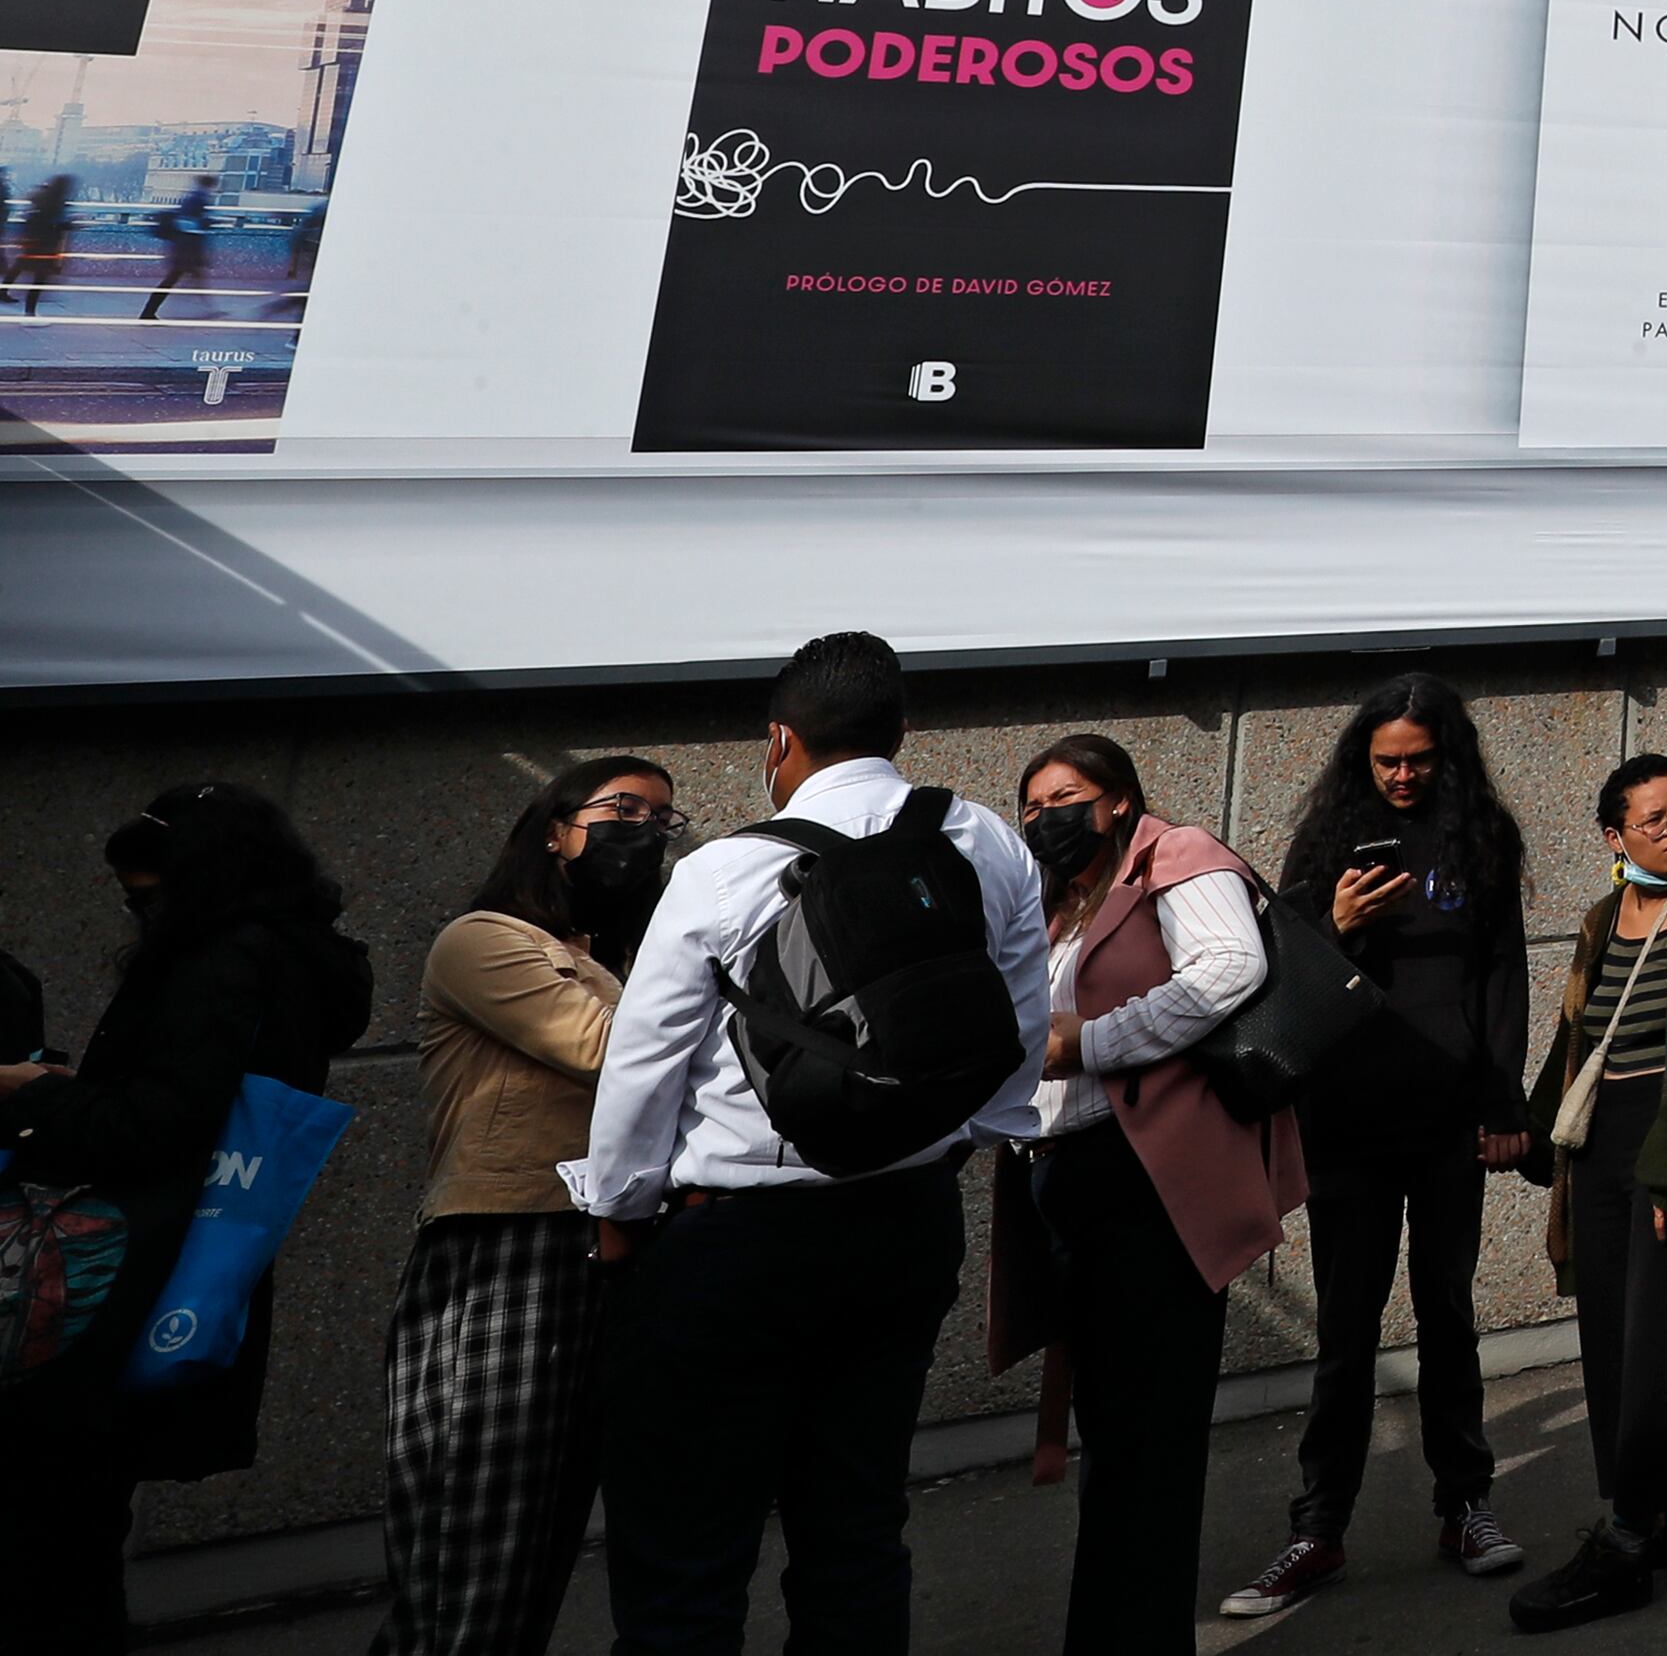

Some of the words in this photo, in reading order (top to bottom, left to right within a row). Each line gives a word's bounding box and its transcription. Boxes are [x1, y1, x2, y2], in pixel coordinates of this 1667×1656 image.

[757, 24, 1195, 96] PODEROSOS
[786, 273, 907, 295] PRÓLOGO
[915, 276, 944, 295] DE
[951, 277, 1018, 296] DAVID
[1026, 276, 1112, 297] GÓMEZ
[192, 348, 255, 363] taurus
